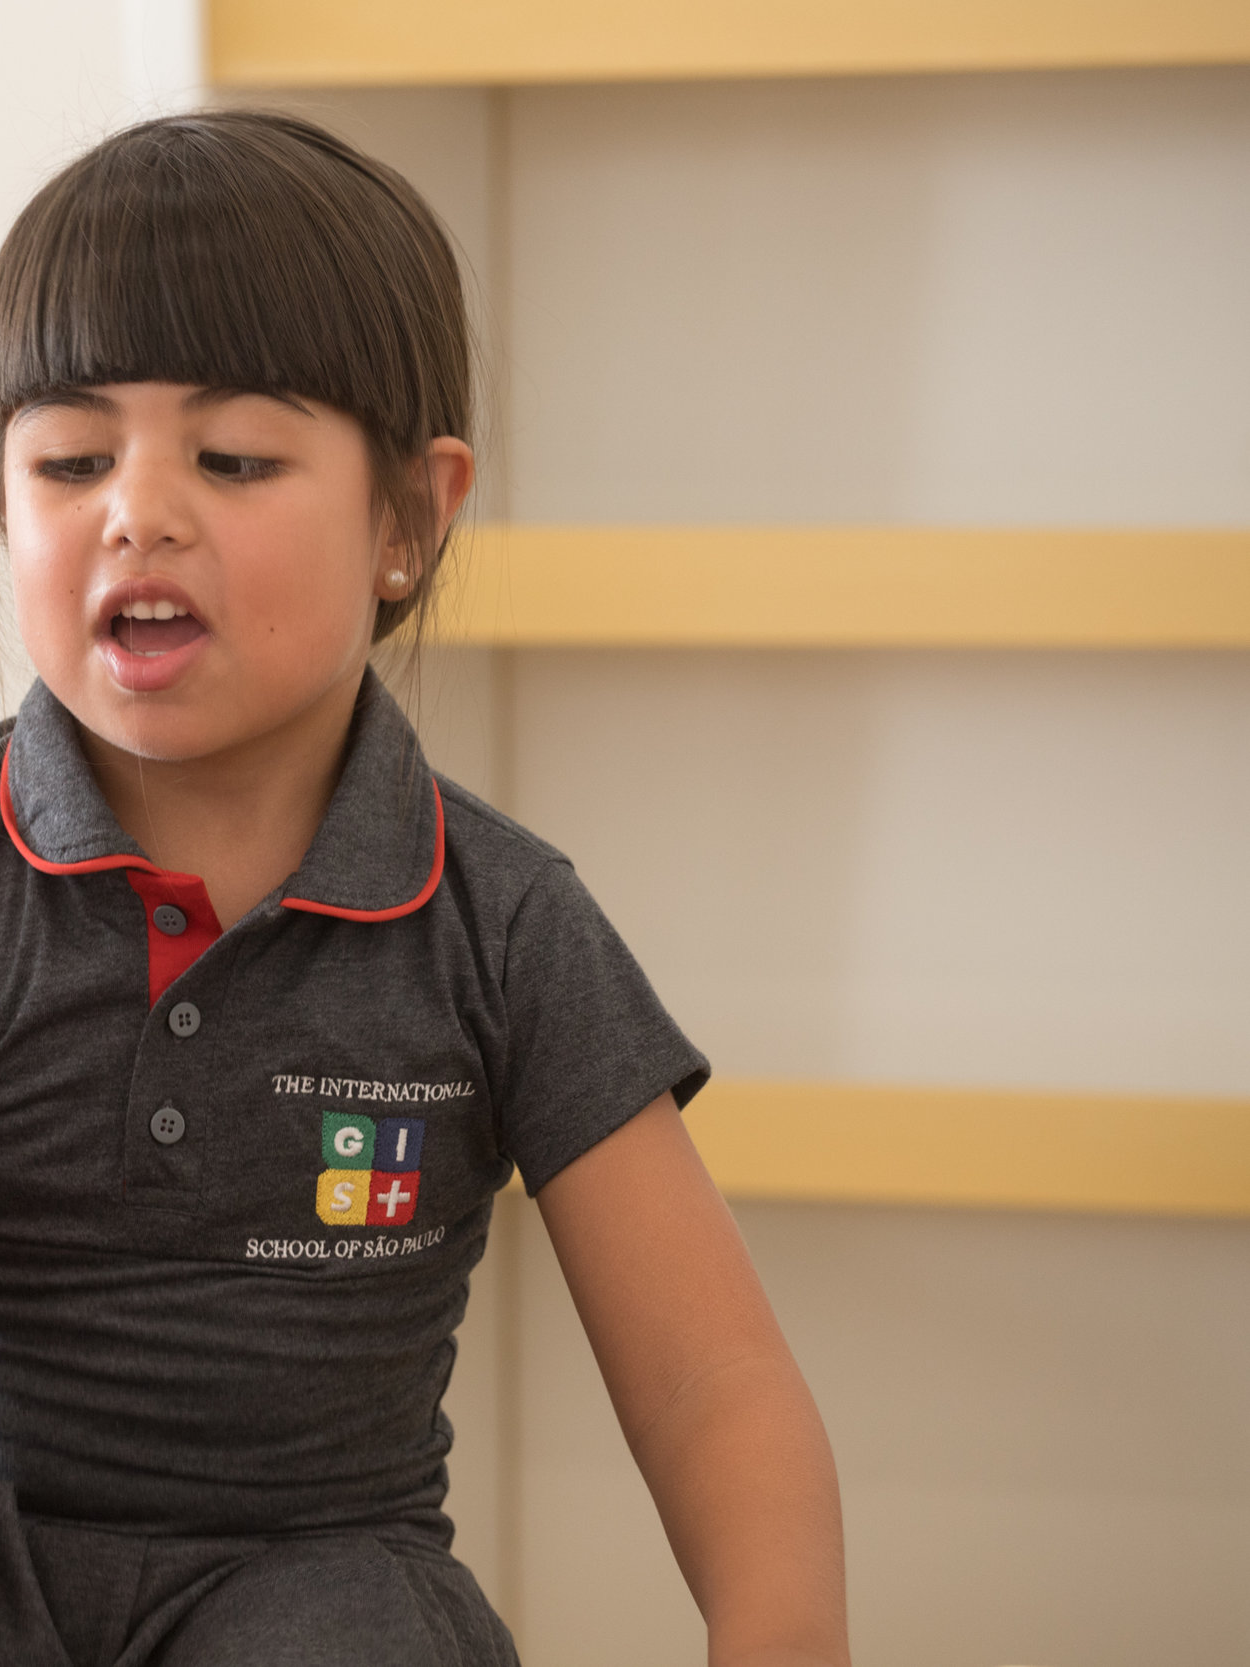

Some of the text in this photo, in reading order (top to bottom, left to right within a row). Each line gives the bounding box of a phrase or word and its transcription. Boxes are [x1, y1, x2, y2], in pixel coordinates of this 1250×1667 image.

[272, 1074, 476, 1102] THE INTERNATIONAL
[246, 1225, 445, 1259] SCHOOL OF SÃO PAULO
